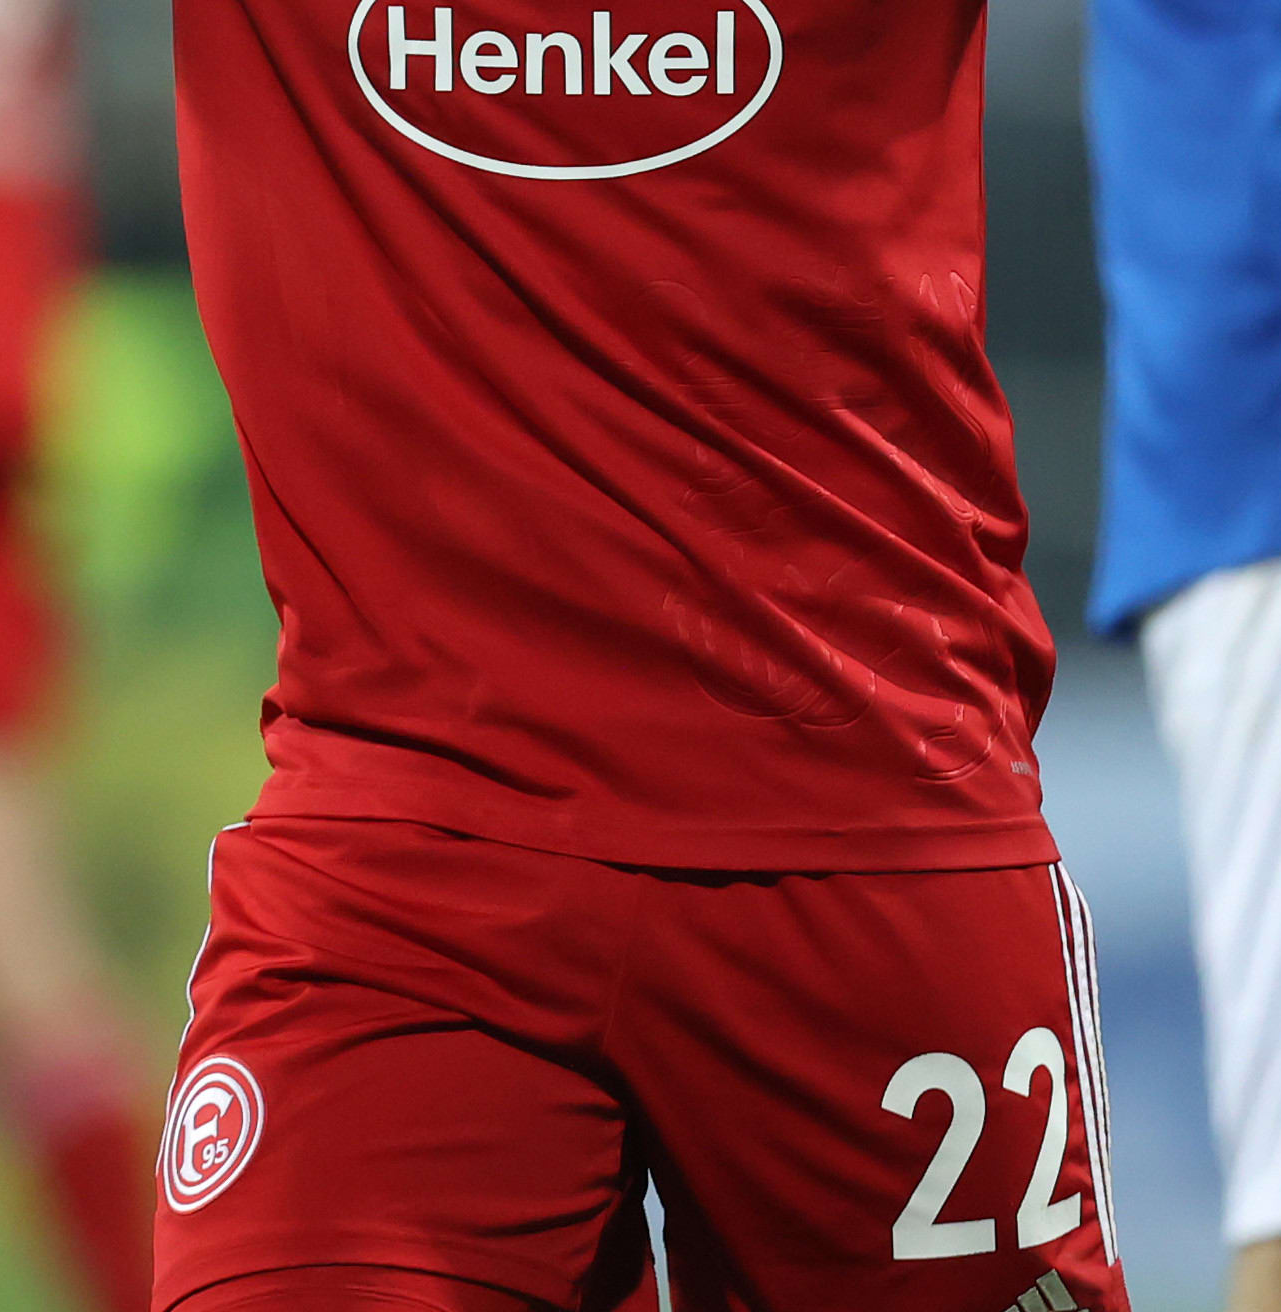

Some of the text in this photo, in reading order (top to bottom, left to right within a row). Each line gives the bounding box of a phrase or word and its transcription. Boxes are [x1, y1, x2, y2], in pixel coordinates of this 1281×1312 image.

[387, 5, 736, 97] Henkel
[180, 1086, 235, 1183] F 95
[880, 1026, 1082, 1261] 22
